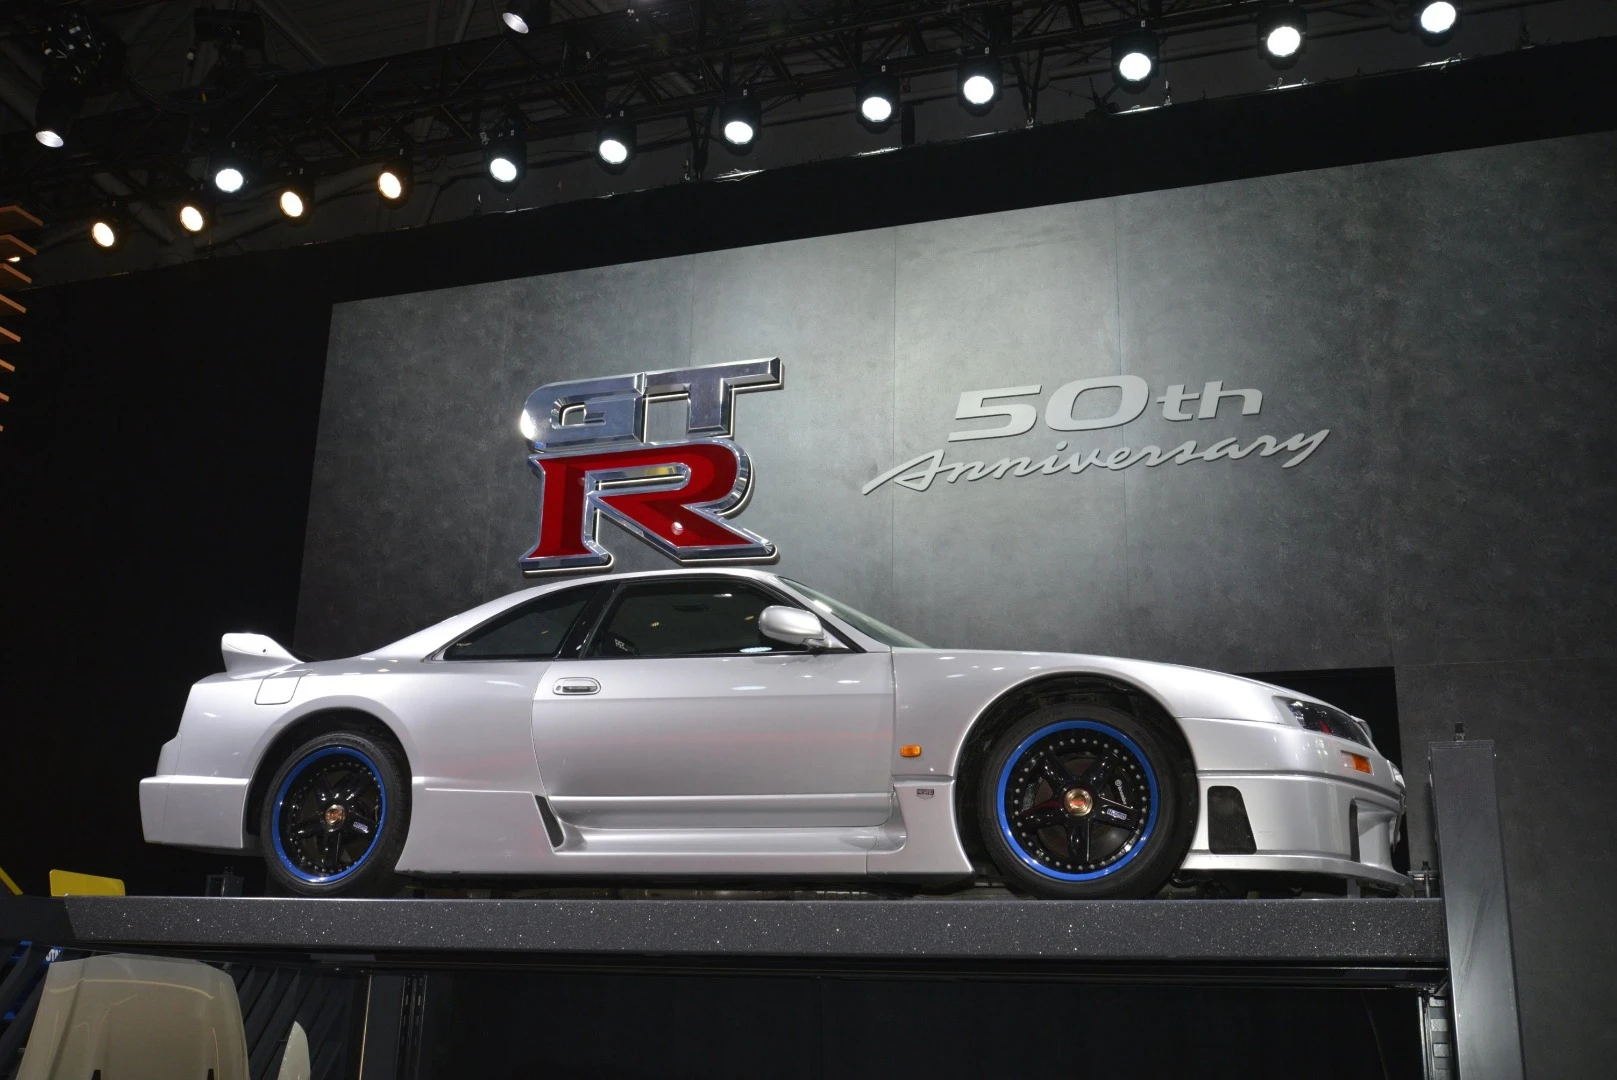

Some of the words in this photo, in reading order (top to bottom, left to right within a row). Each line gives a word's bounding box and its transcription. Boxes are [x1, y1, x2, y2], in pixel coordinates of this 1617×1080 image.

[520, 357, 784, 452] GT
[948, 374, 1263, 443] 50th
[862, 429, 1330, 495] Anniversary
[519, 438, 779, 575] R
